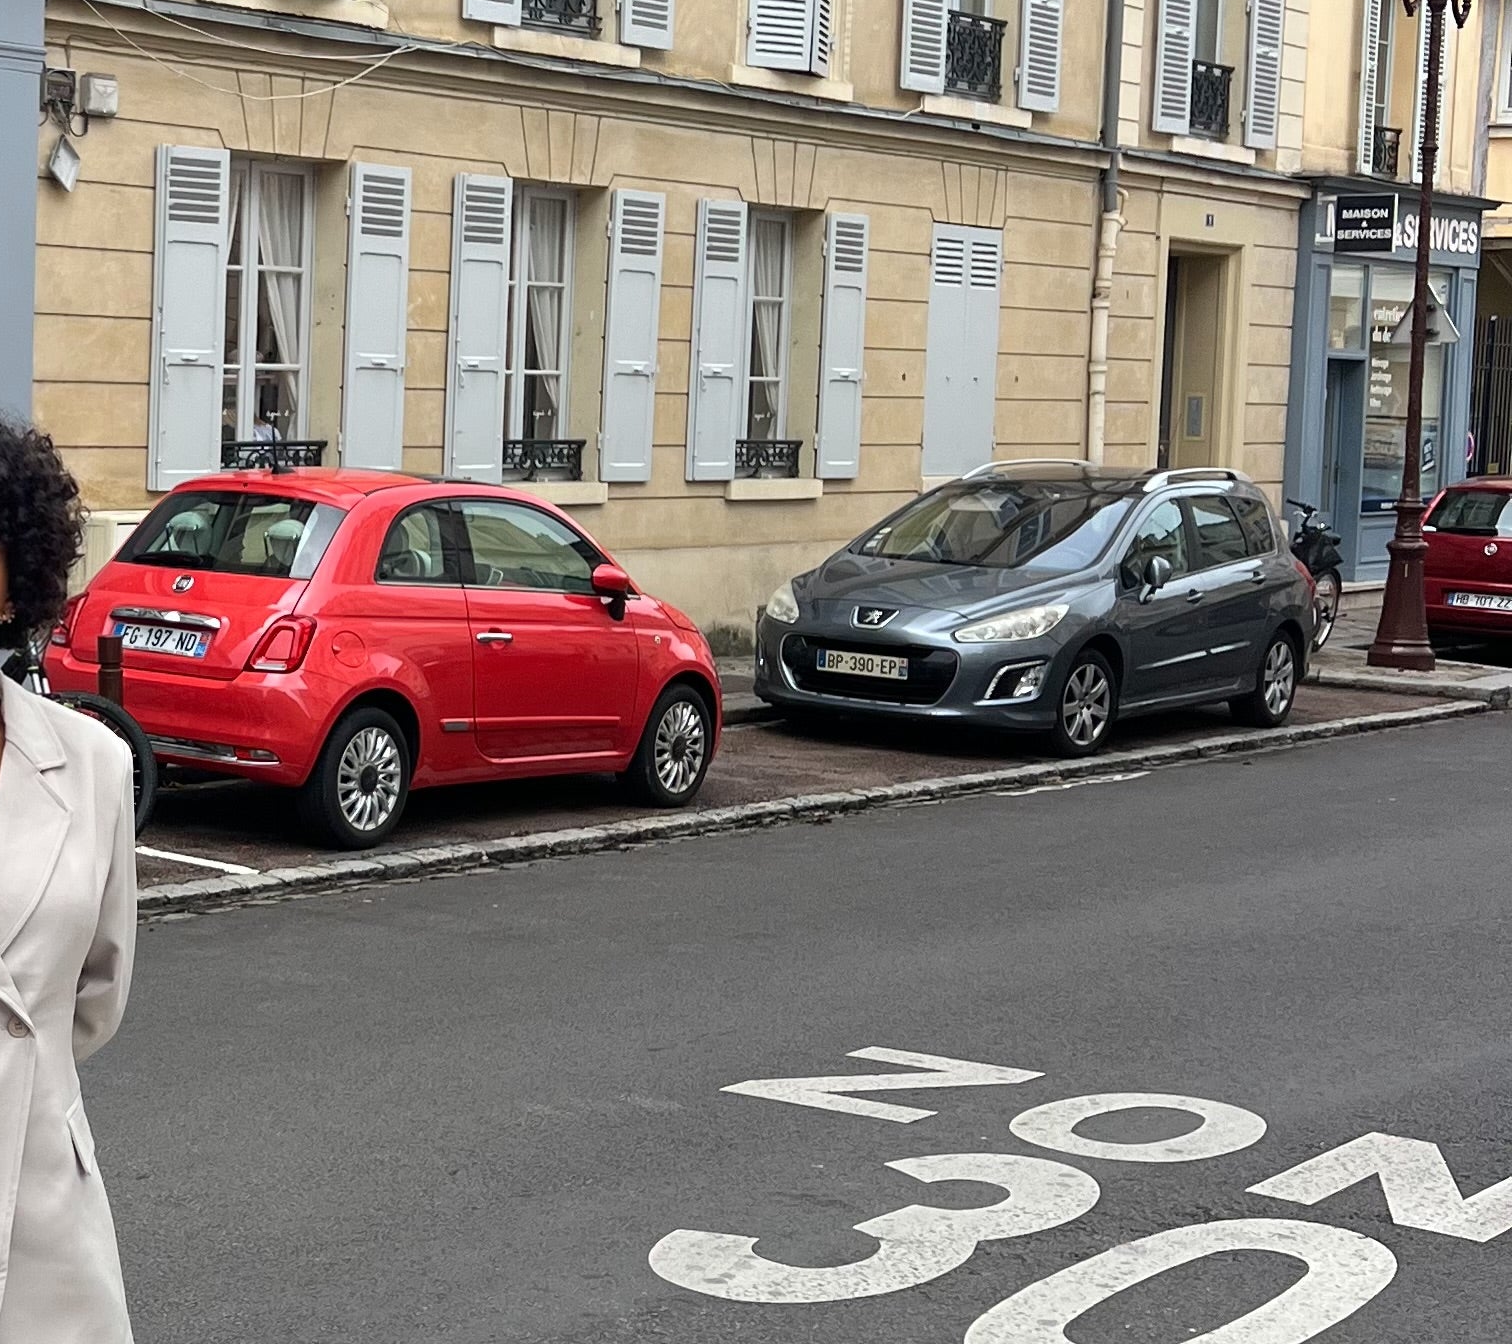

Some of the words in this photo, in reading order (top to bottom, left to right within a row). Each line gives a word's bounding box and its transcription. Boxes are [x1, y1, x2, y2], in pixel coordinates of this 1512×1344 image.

[1342, 208, 1389, 219] MAISON
[1337, 229, 1392, 240] SERVICES
[122, 625, 198, 653] FG-197-ND
[828, 653, 897, 675] BP-390-EP
[719, 1045, 1512, 1243] ZON
